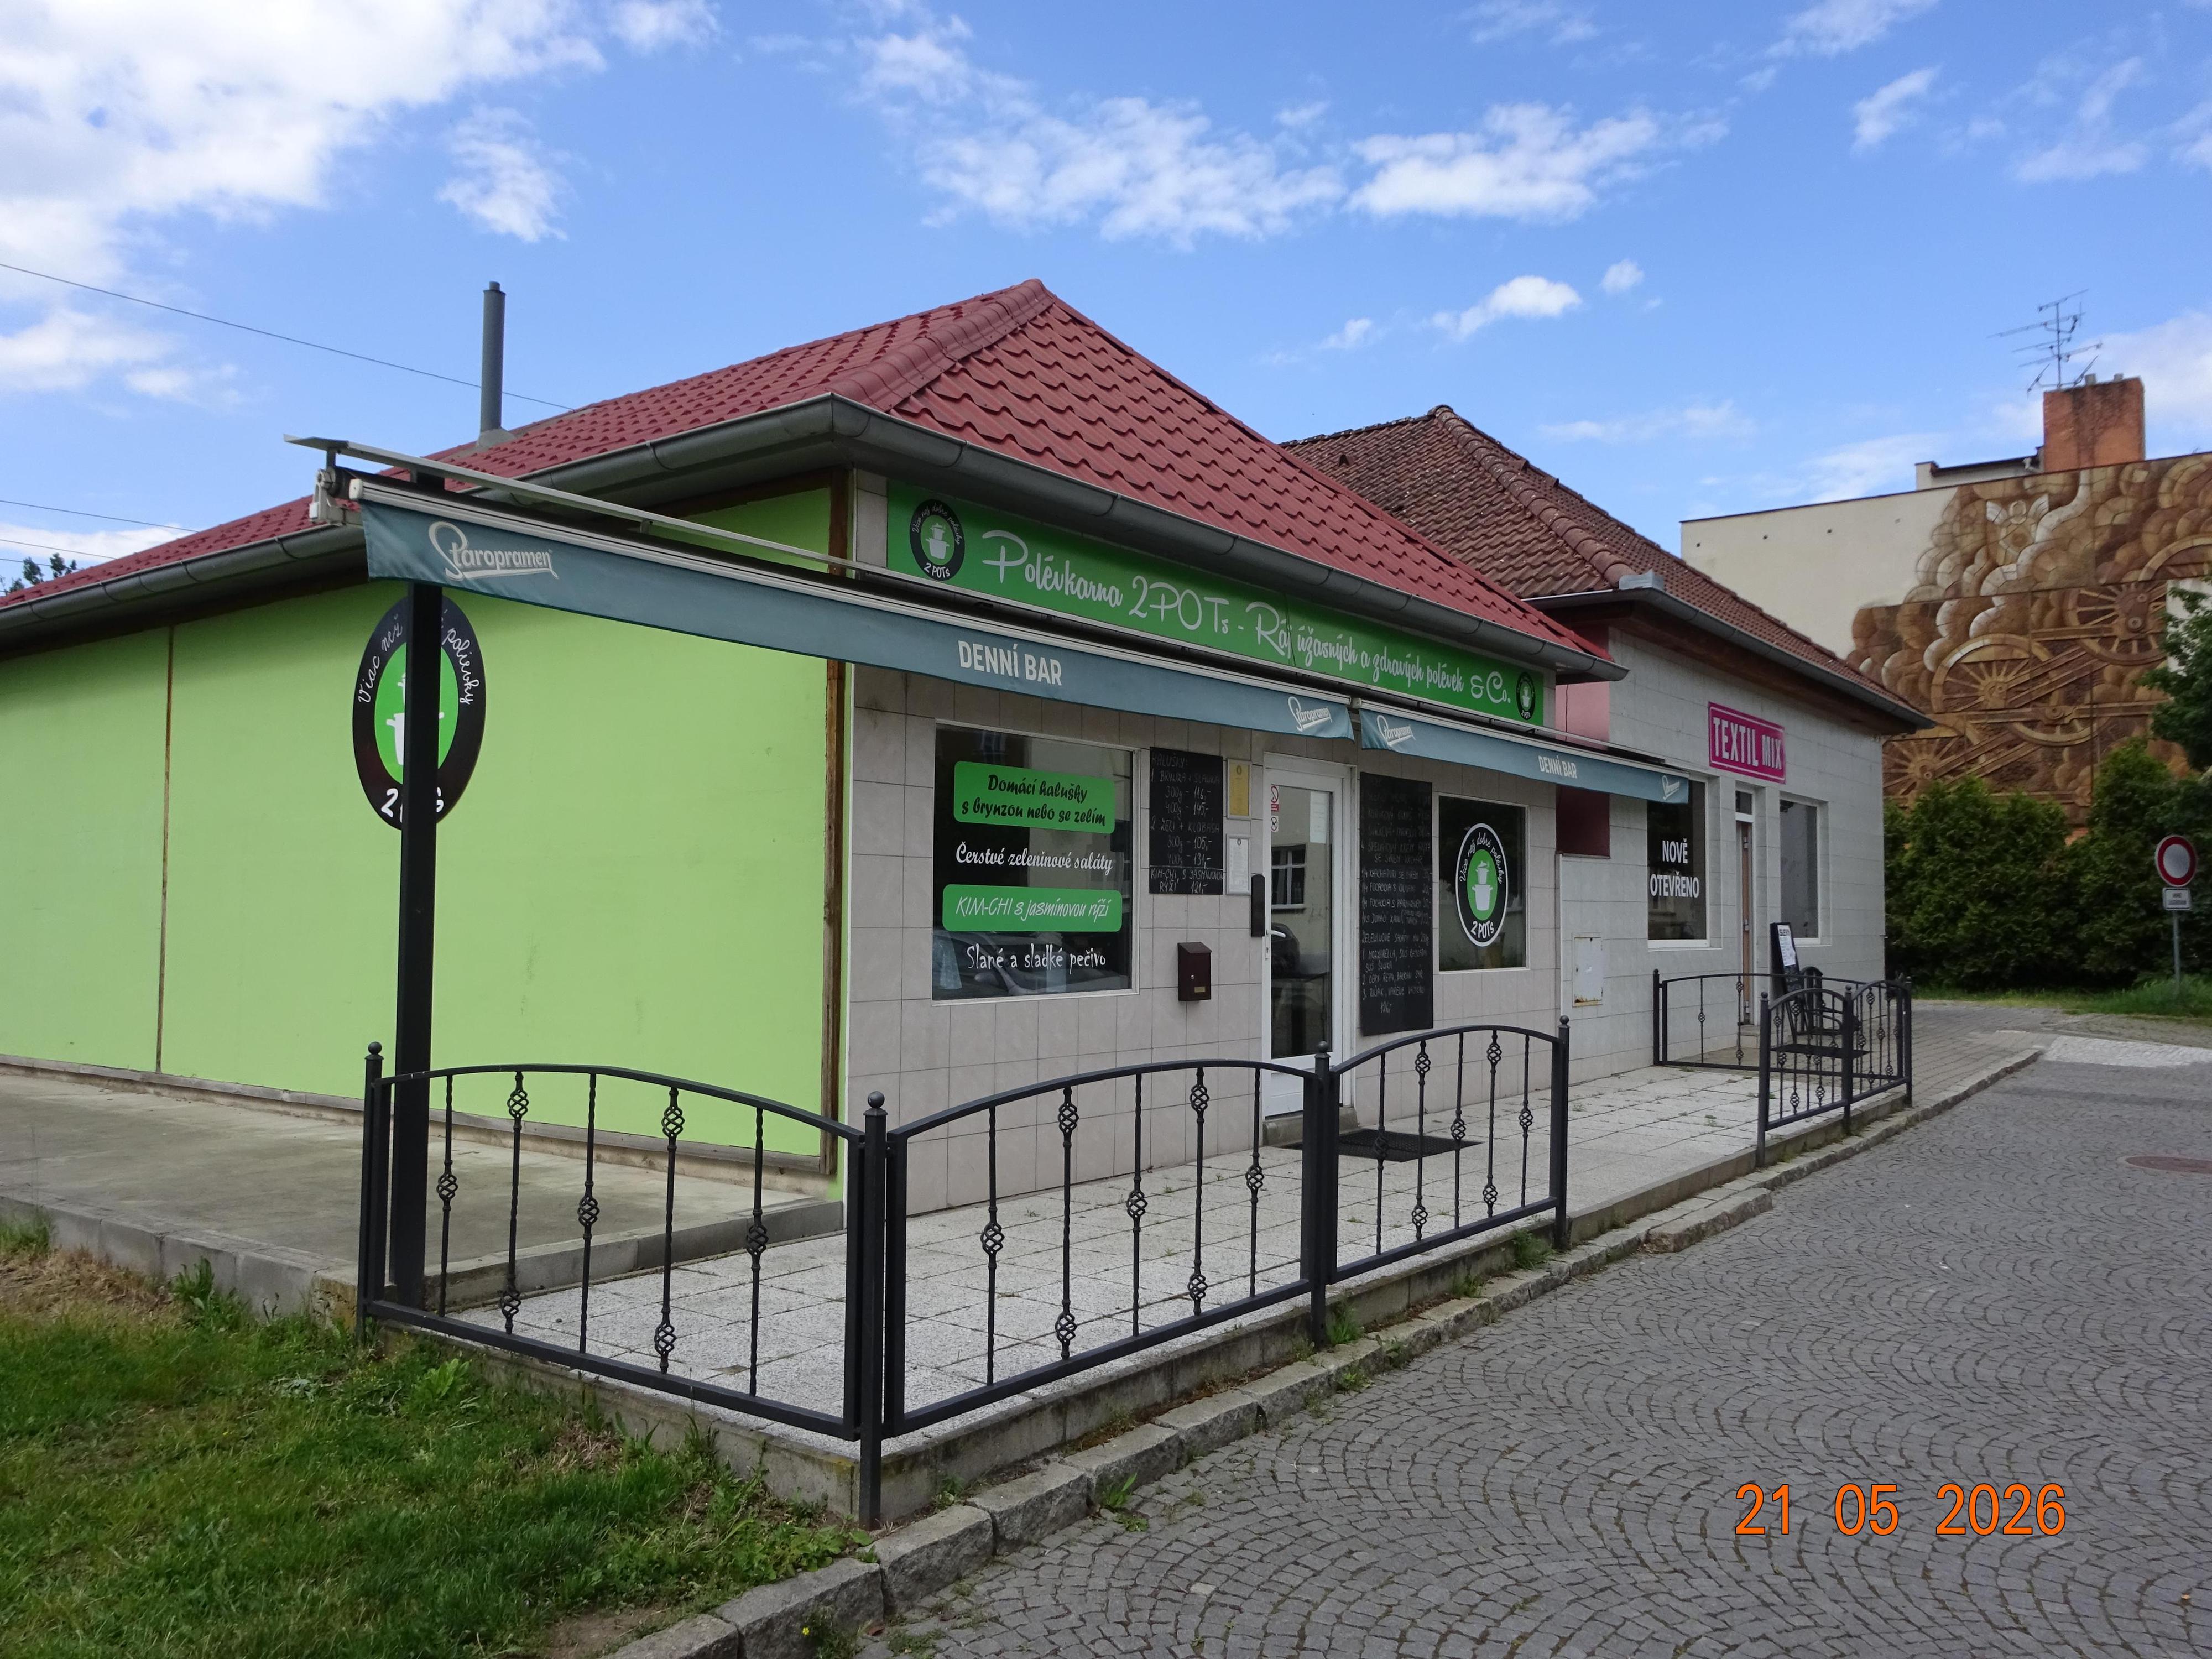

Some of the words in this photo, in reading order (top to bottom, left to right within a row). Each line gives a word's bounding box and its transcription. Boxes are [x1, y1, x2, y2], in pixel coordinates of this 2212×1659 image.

[429, 521, 559, 581] Staropramen
[924, 562, 932, 573] 2
[982, 529, 1123, 608] Polévkarna
[1245, 601, 1292, 660] Ráj
[1297, 626, 1358, 670] úžasných
[1361, 651, 1370, 668] a
[1372, 645, 1425, 689] zdravých
[1426, 661, 1465, 693] polévek
[358, 655, 380, 703] Viac
[442, 628, 479, 706] polievky
[958, 640, 1019, 679] DENNÍ
[1024, 653, 1062, 686] BAR
[1288, 696, 1333, 733] Staropramen
[1376, 715, 1416, 748] Staropramen
[1713, 717, 1759, 767] TEXTIL
[1762, 736, 1783, 770] MIX
[1538, 755, 1562, 778] DENNÍ
[1562, 760, 1578, 779] BAR
[987, 774, 1037, 796] Domácí
[1039, 781, 1088, 804] halušky
[961, 800, 969, 815] s
[973, 797, 1023, 818] brynzou
[1027, 801, 1055, 821] nebo
[1058, 808, 1071, 822] se
[1074, 808, 1106, 827] zelím
[1477, 832, 1492, 848] dobré
[1662, 838, 1688, 864] NOVĚ
[956, 841, 1005, 866] Čerstvé
[1007, 848, 1072, 868] zeleninové
[1074, 851, 1113, 876] saláty
[1650, 870, 1700, 899] OTEVŘENO
[956, 896, 1013, 917] KIM-CHI
[1014, 902, 1024, 916] s
[1023, 898, 1086, 922] jasmínovou
[1089, 898, 1112, 924] rýží
[1470, 920, 1478, 936] 2
[966, 943, 1003, 971] Slané
[1010, 955, 1018, 968] a
[1024, 943, 1063, 969] sladké
[1069, 947, 1107, 975] pečivo
